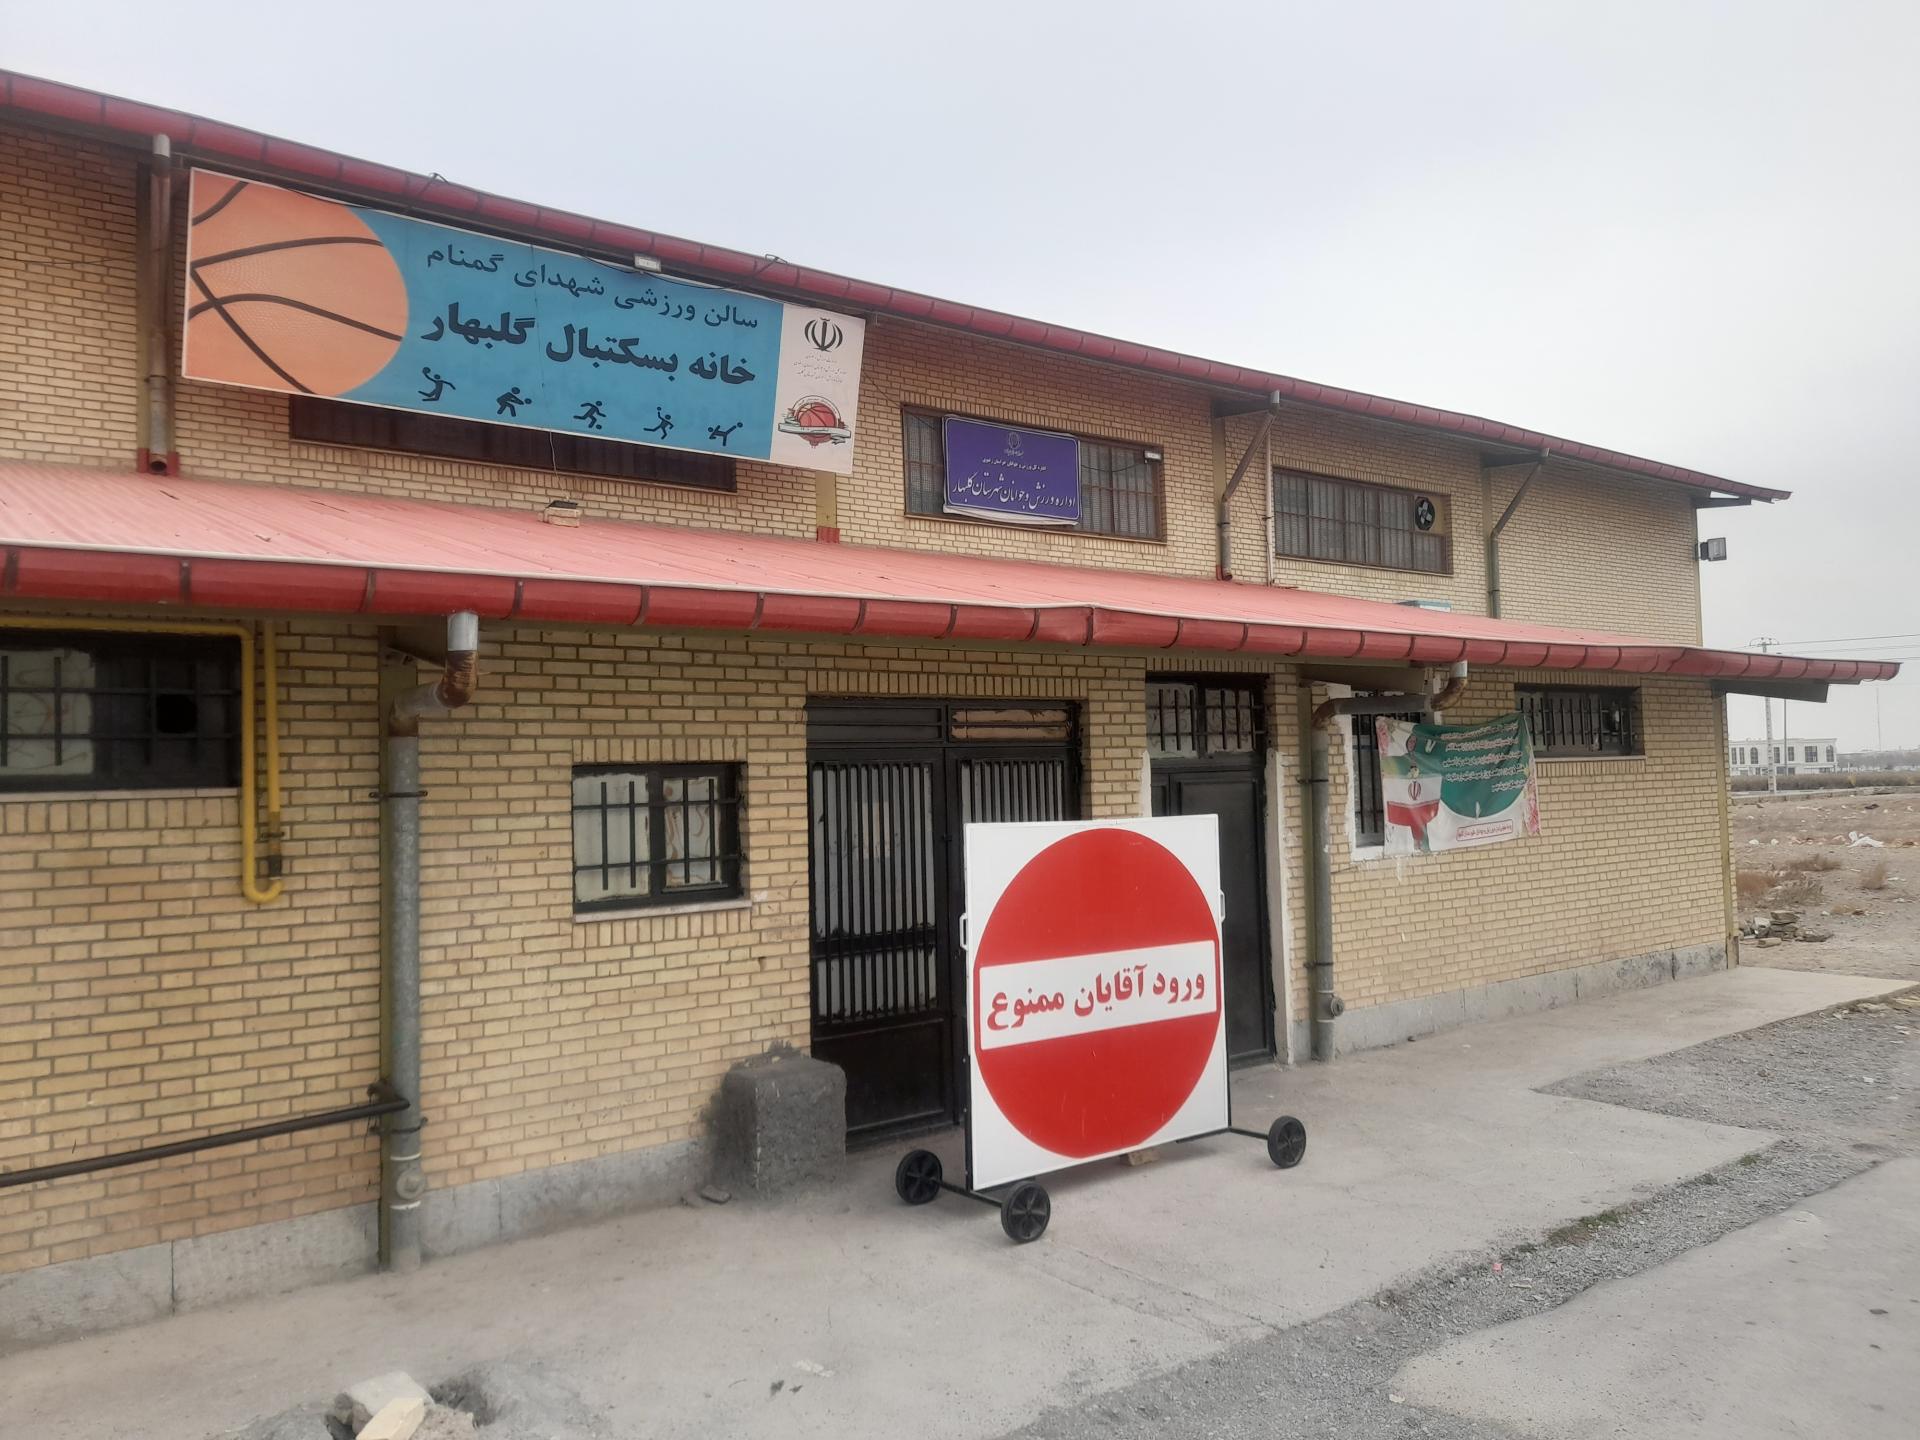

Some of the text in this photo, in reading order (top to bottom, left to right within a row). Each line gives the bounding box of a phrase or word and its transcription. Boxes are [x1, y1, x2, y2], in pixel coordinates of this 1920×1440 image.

[426, 243, 759, 329] سالن ورزشی شهدای گمنام
[420, 302, 758, 385] خانه بسکتبال گلبهار
[971, 472, 1005, 499] شهرستان
[1028, 481, 1055, 510] ورزش
[1055, 495, 1076, 508] اداره
[986, 964, 1206, 1031] ورود آقایان ممنوع
